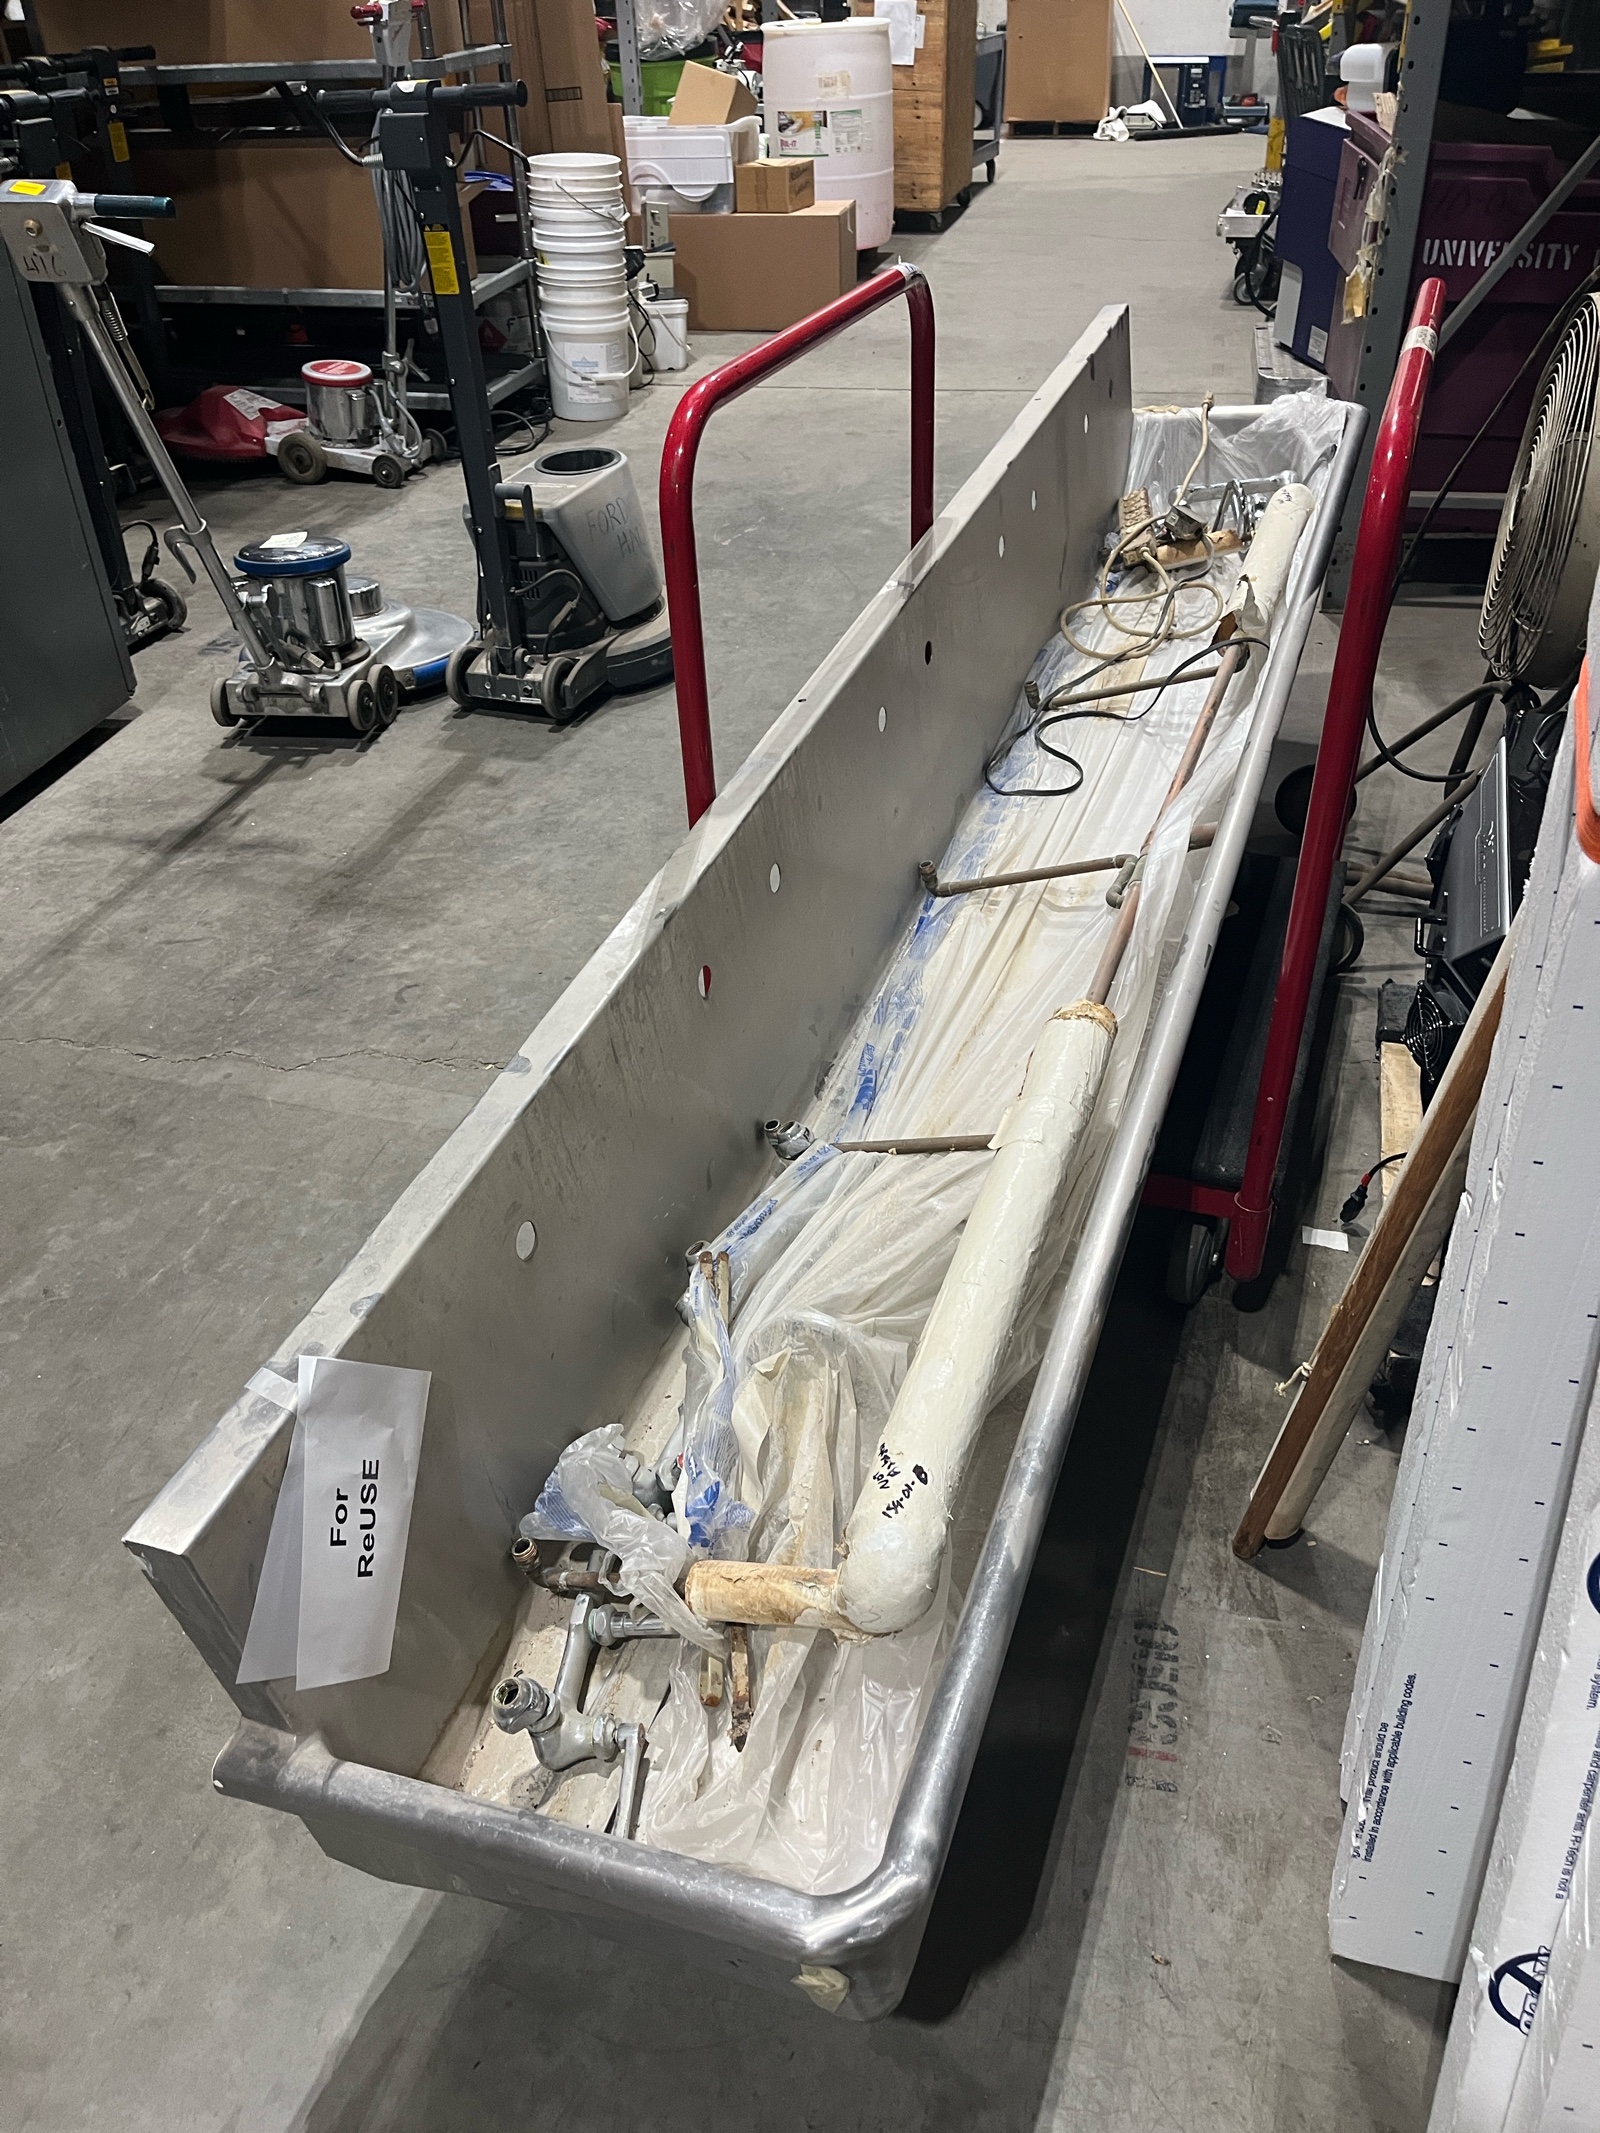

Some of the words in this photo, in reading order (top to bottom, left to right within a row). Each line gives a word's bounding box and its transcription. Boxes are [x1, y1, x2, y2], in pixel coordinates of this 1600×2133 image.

[1422, 239, 1580, 270] UNIVESITY
[329, 1487, 350, 1548] For
[357, 1458, 381, 1579] ReUSE
[1403, 1672, 1417, 1699] codes.
[1380, 1722, 1389, 1733] be
[1395, 1699, 1413, 1729] building
[1387, 1728, 1402, 1769] applicable
[1384, 1769, 1394, 1786] with
[1580, 1767, 1599, 1817] carpenter
[1373, 1786, 1390, 1826] accordance
[1564, 1833, 1582, 1867] R-Tech
[1559, 1875, 1570, 1892] not
